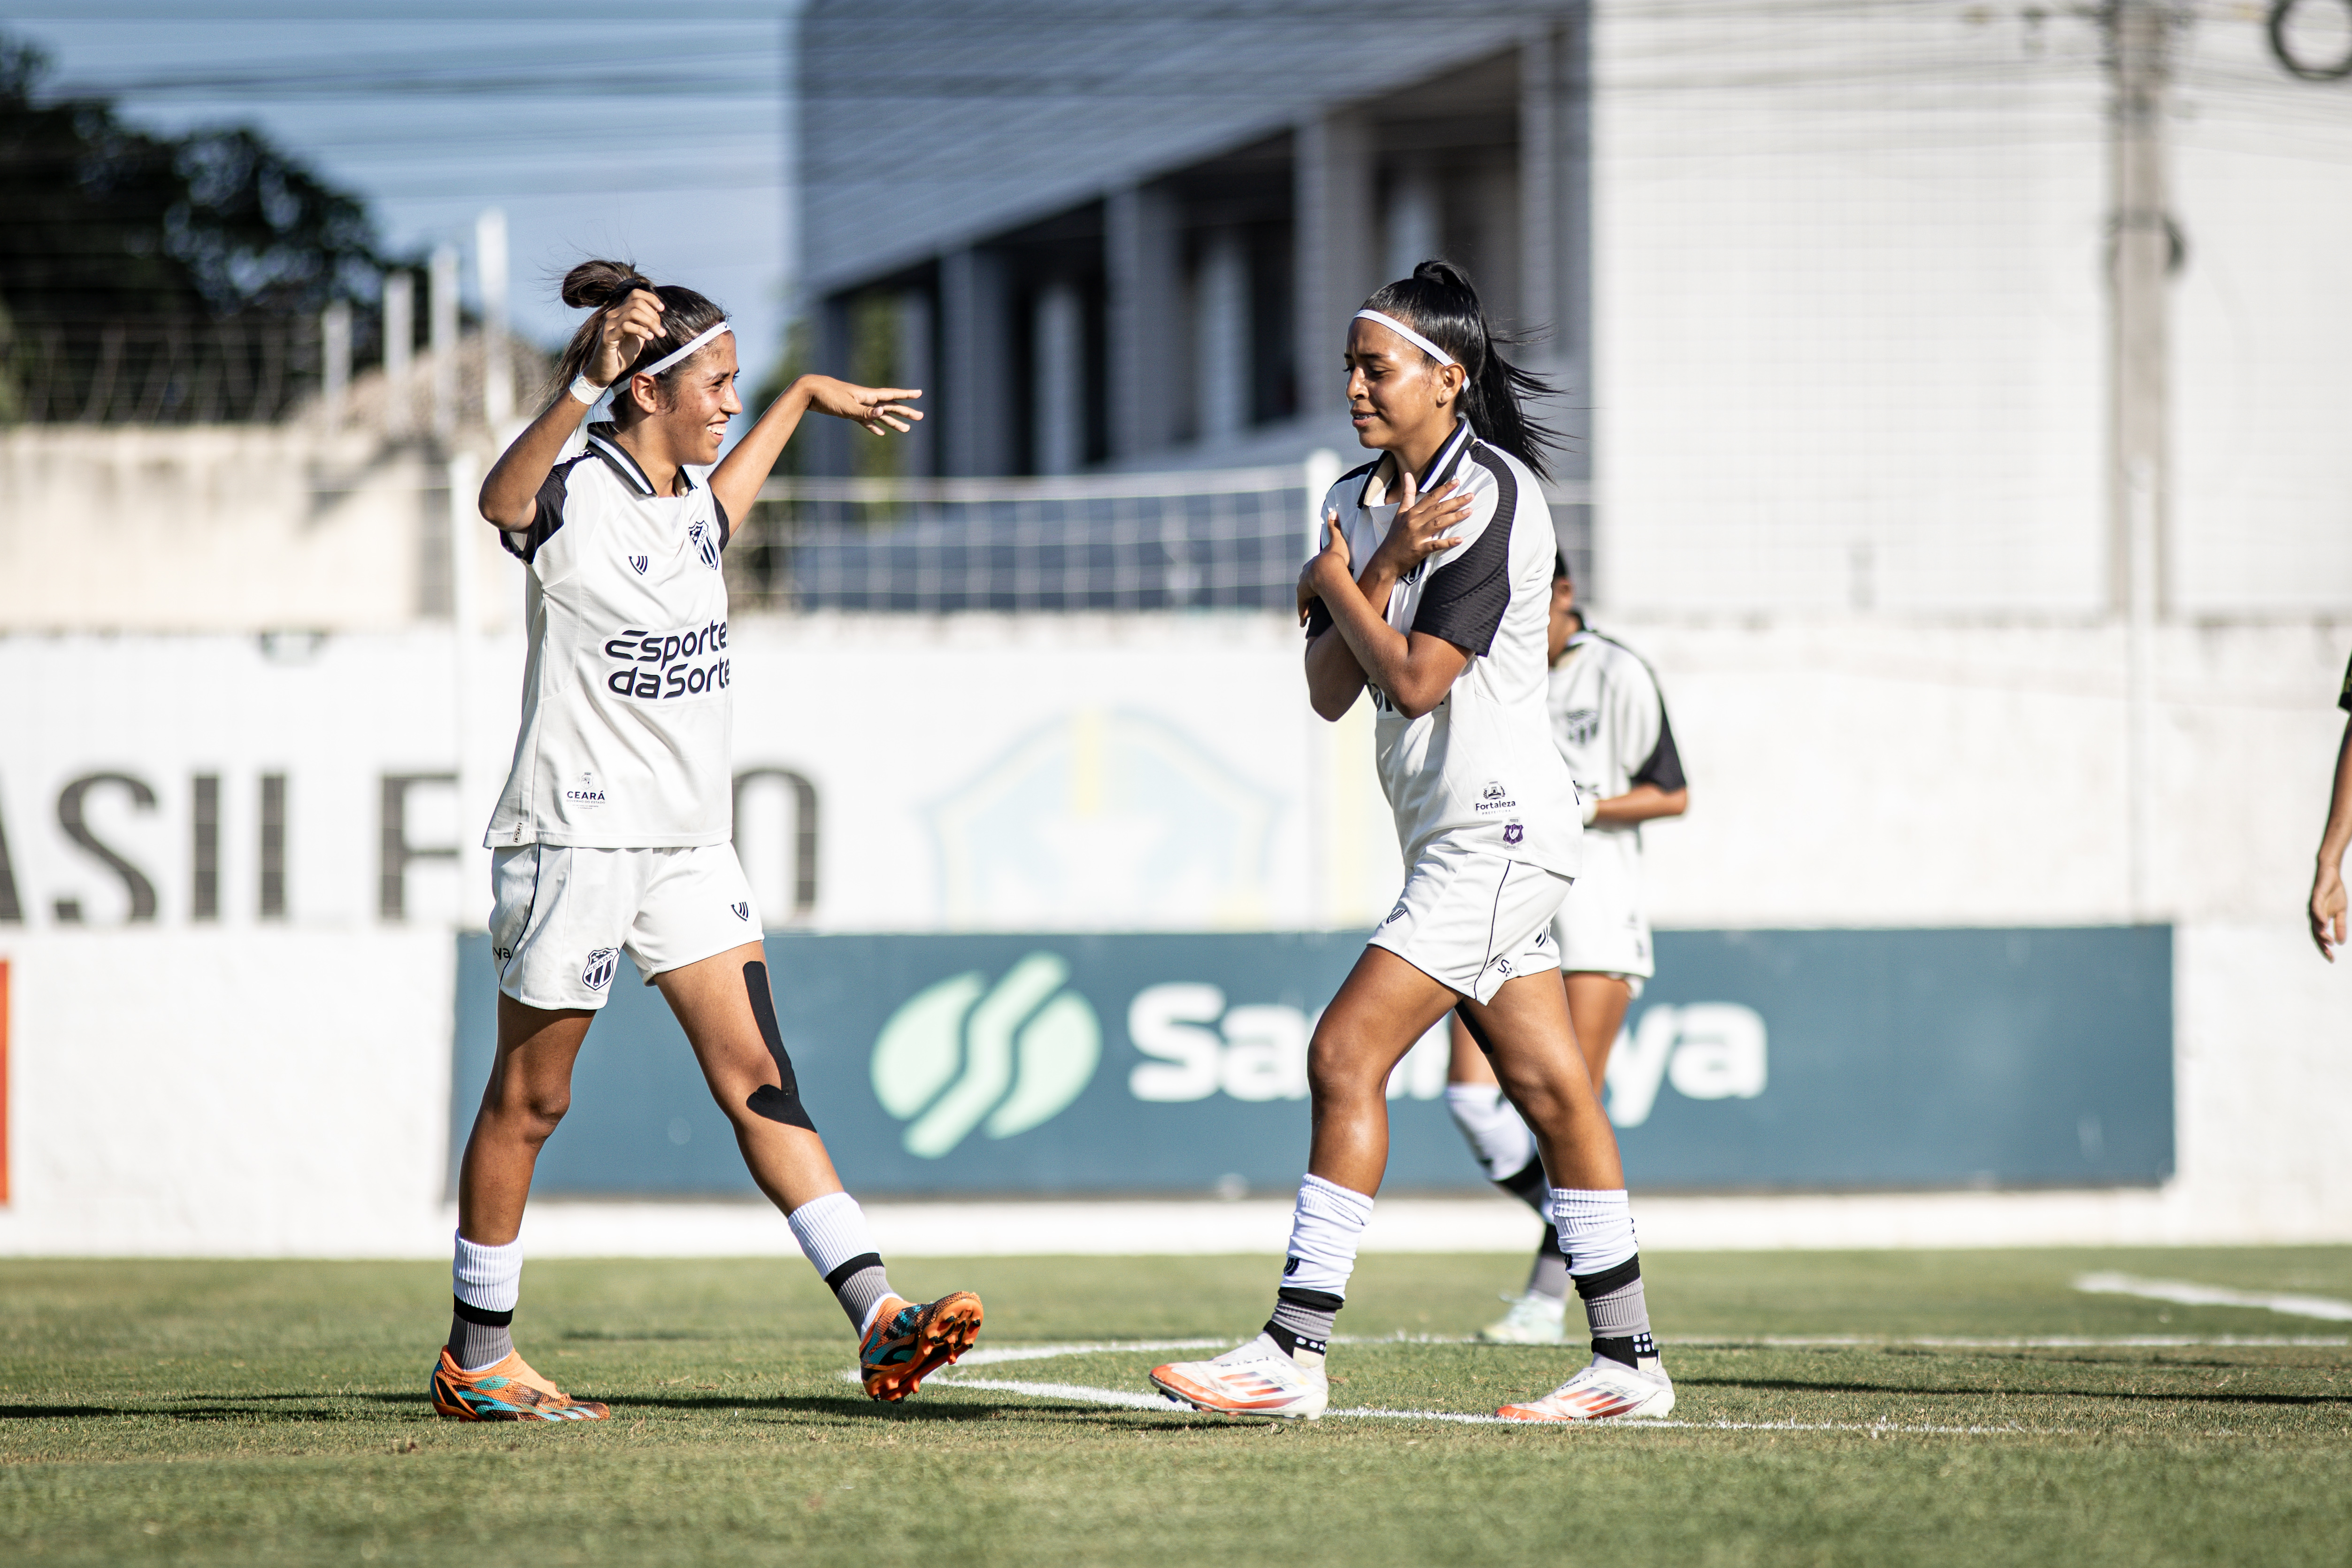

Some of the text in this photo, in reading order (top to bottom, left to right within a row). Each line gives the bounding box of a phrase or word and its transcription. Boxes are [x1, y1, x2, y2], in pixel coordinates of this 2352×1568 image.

[605, 619, 726, 672] Esporte
[567, 790, 605, 800] CEARÁ
[1476, 800, 1516, 811] Fortaleza
[492, 947, 511, 960] ya
[1597, 1381, 1640, 1398] F50
